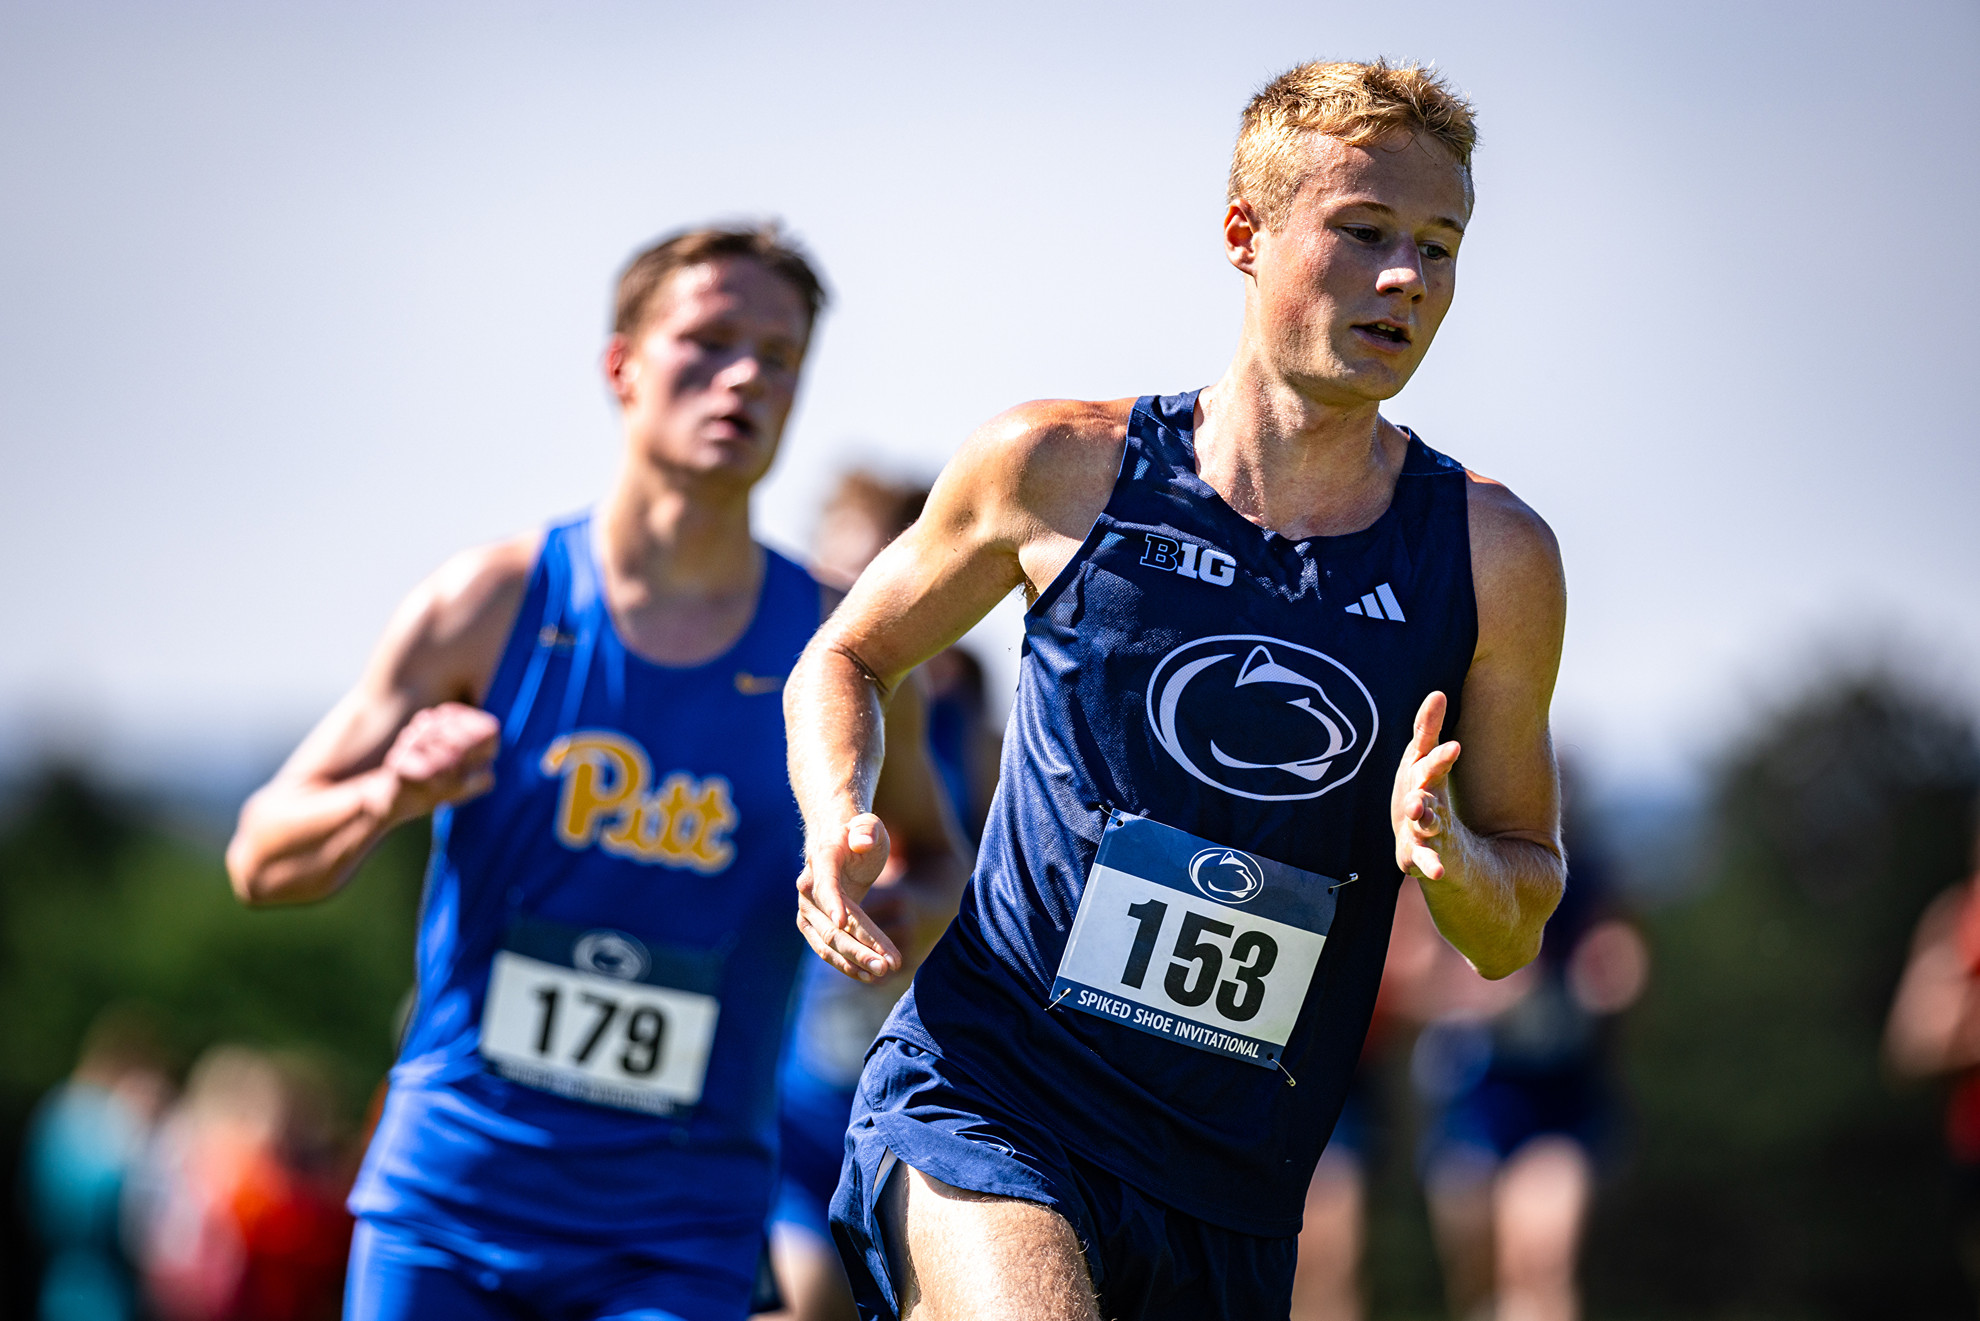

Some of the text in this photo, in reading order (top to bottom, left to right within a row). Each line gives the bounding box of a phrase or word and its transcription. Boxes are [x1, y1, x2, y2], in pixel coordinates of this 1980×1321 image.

[543, 731, 738, 871] Pitt
[1120, 898, 1279, 1022] 153
[533, 986, 666, 1078] 179
[1077, 989, 1260, 1059] SPIKED SHOE INVITATIONAL
